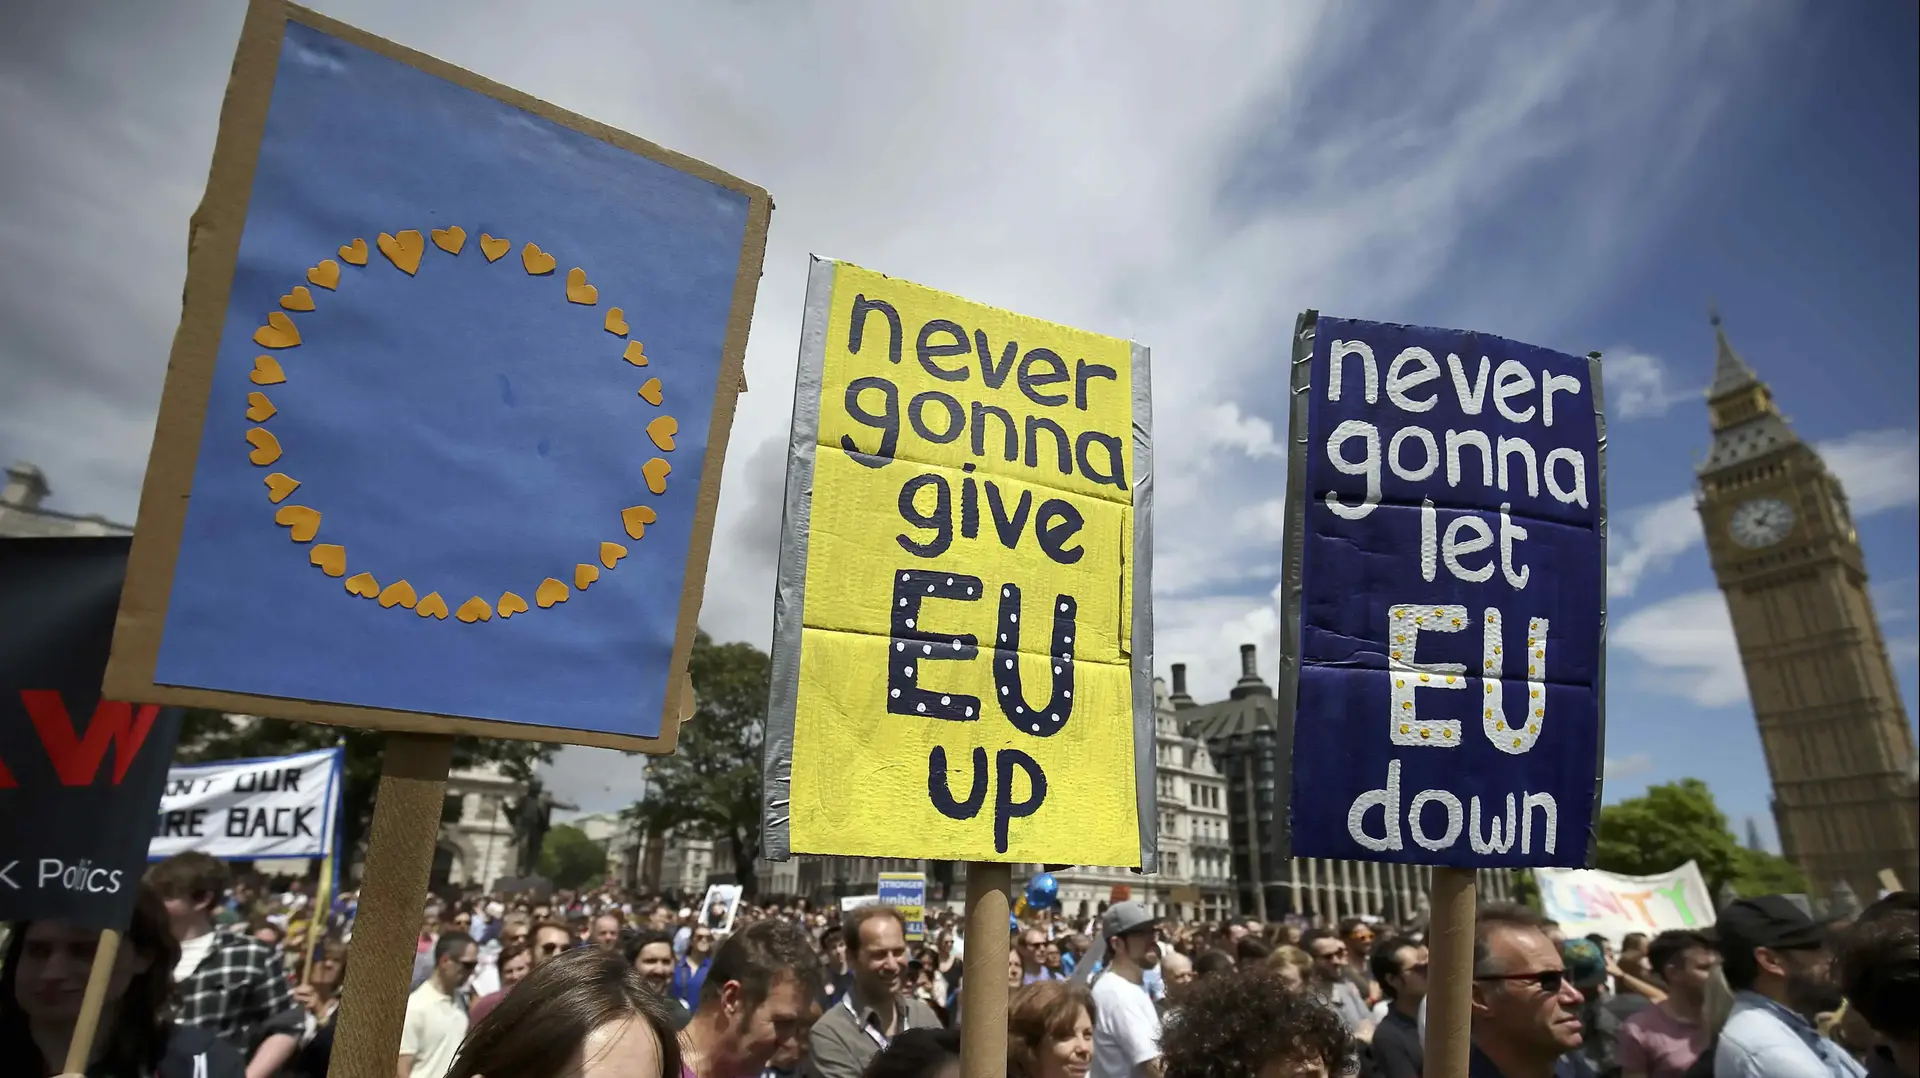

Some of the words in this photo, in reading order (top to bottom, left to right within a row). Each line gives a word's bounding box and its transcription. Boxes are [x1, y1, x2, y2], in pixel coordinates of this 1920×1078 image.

[848, 293, 1118, 411] never
[1328, 339, 1581, 427] never
[841, 377, 1129, 491] gonna
[1325, 420, 1589, 520] gonna
[896, 463, 1085, 564] give
[1420, 494, 1530, 590] let
[887, 569, 1077, 737] EU
[1388, 604, 1549, 755] EU
[225, 806, 317, 838] BACK
[233, 768, 302, 793] OUR
[928, 745, 1048, 854] up
[1348, 759, 1558, 855] down
